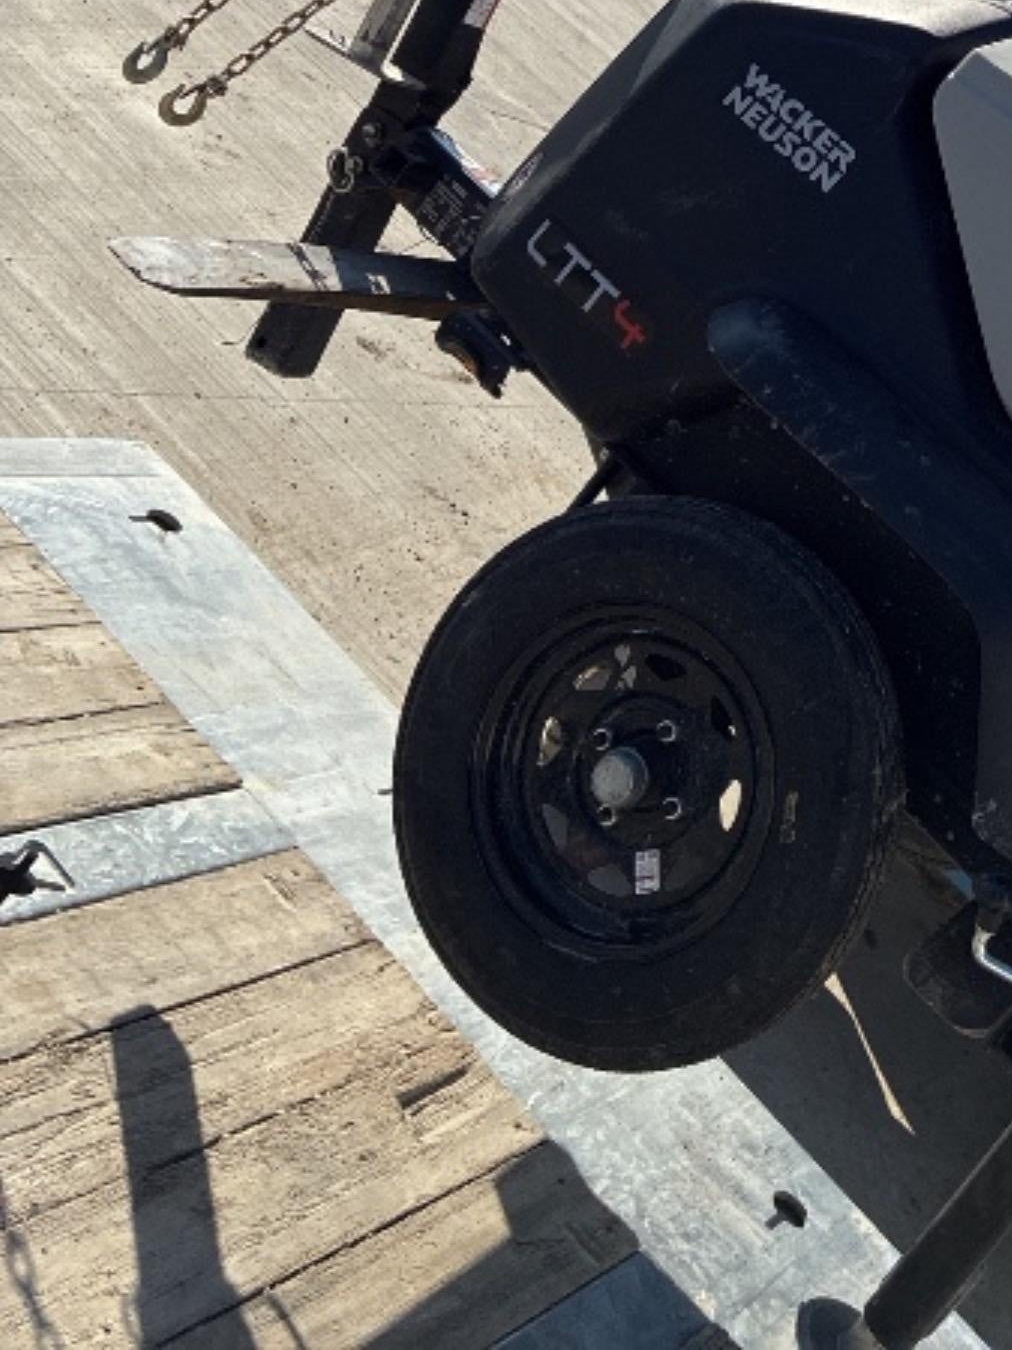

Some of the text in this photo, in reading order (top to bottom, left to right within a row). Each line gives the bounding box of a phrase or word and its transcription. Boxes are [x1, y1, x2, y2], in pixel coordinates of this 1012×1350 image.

[721, 86, 842, 193] NEUSON
[744, 62, 856, 173] WACKER
[526, 217, 647, 349] LTT4
